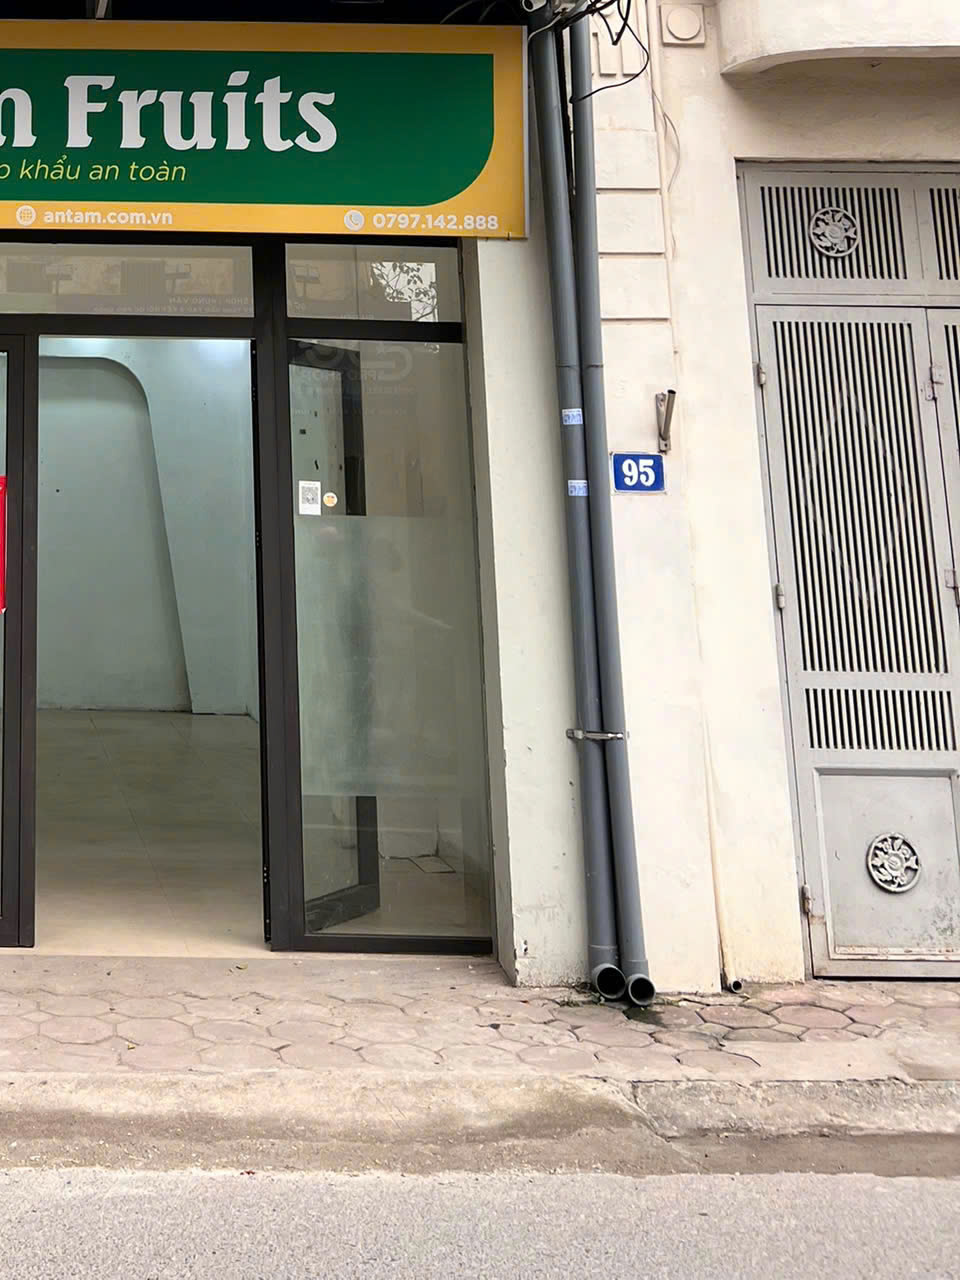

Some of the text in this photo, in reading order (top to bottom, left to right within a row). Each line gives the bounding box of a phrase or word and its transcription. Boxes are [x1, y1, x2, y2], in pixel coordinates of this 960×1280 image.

[64, 70, 338, 153] Fruits
[19, 154, 81, 181] khẩu
[89, 164, 120, 181] an
[129, 160, 186, 182] toàn
[43, 209, 173, 226] antam.com.vn
[372, 212, 499, 230] 0797.142.888
[622, 458, 656, 487] 95
